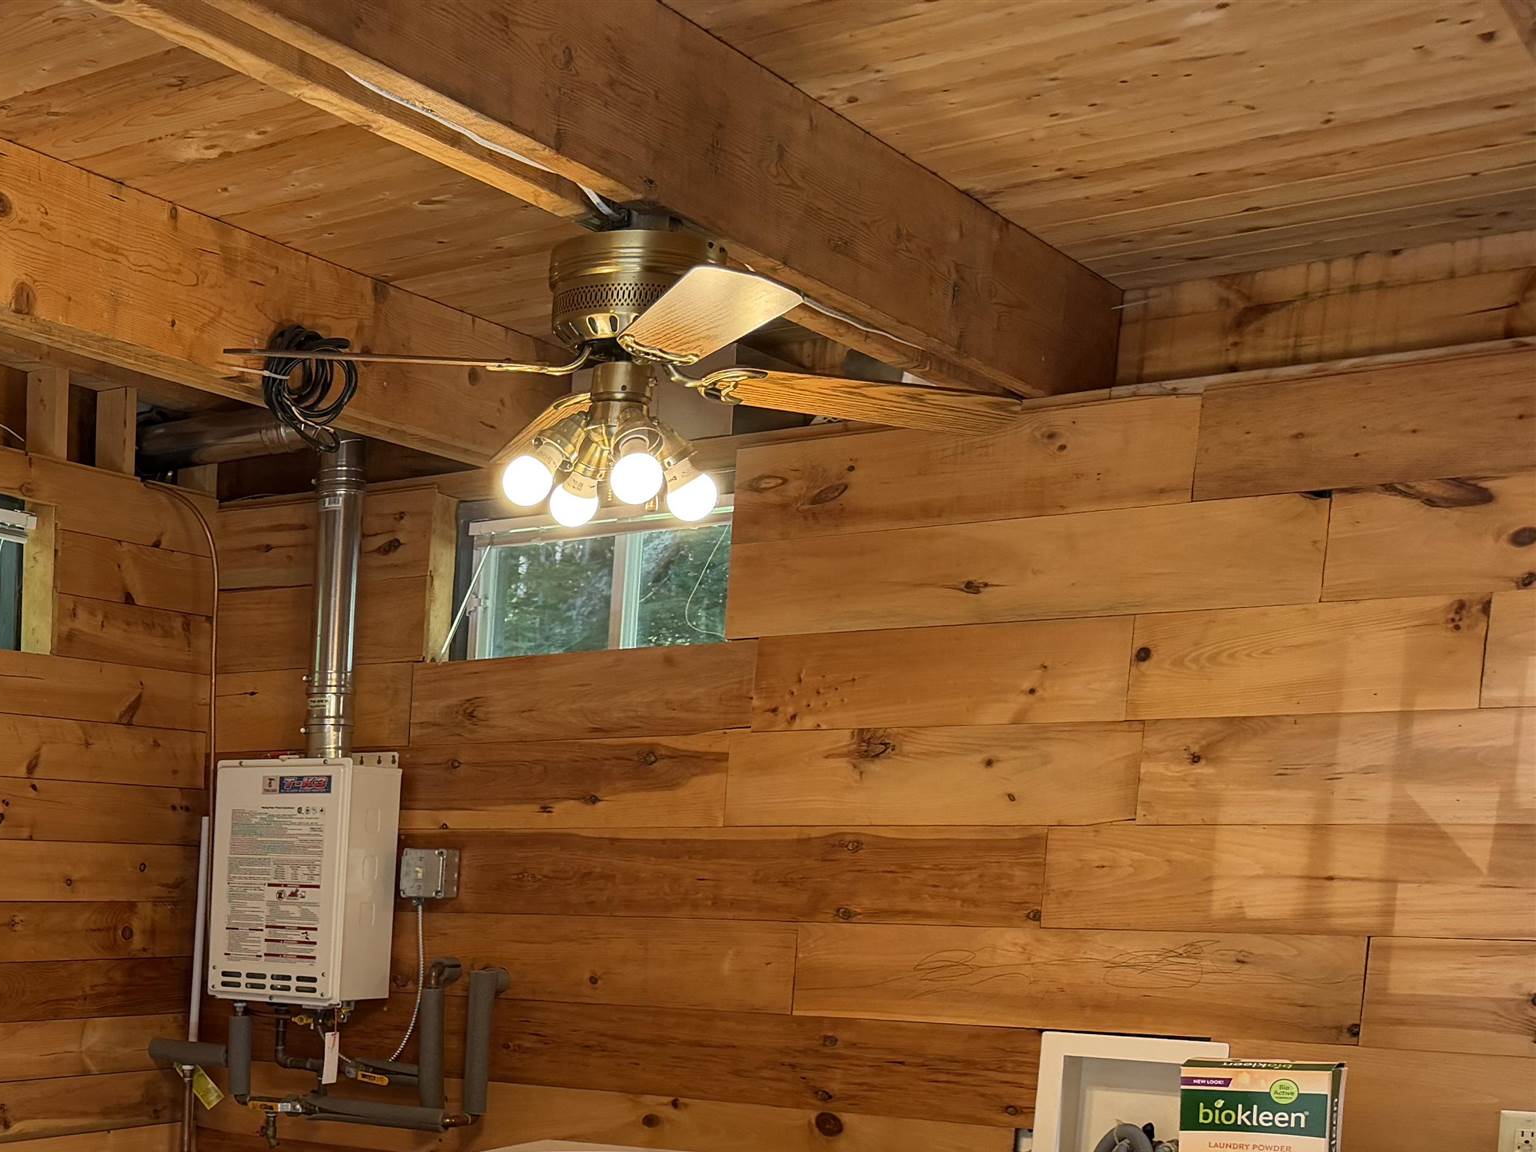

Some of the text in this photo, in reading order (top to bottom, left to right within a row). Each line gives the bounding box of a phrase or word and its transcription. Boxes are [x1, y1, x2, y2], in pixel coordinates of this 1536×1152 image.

[1199, 1100, 1305, 1128] biokleen
[1208, 1142, 1292, 1152] LAUNDRY POWDER
